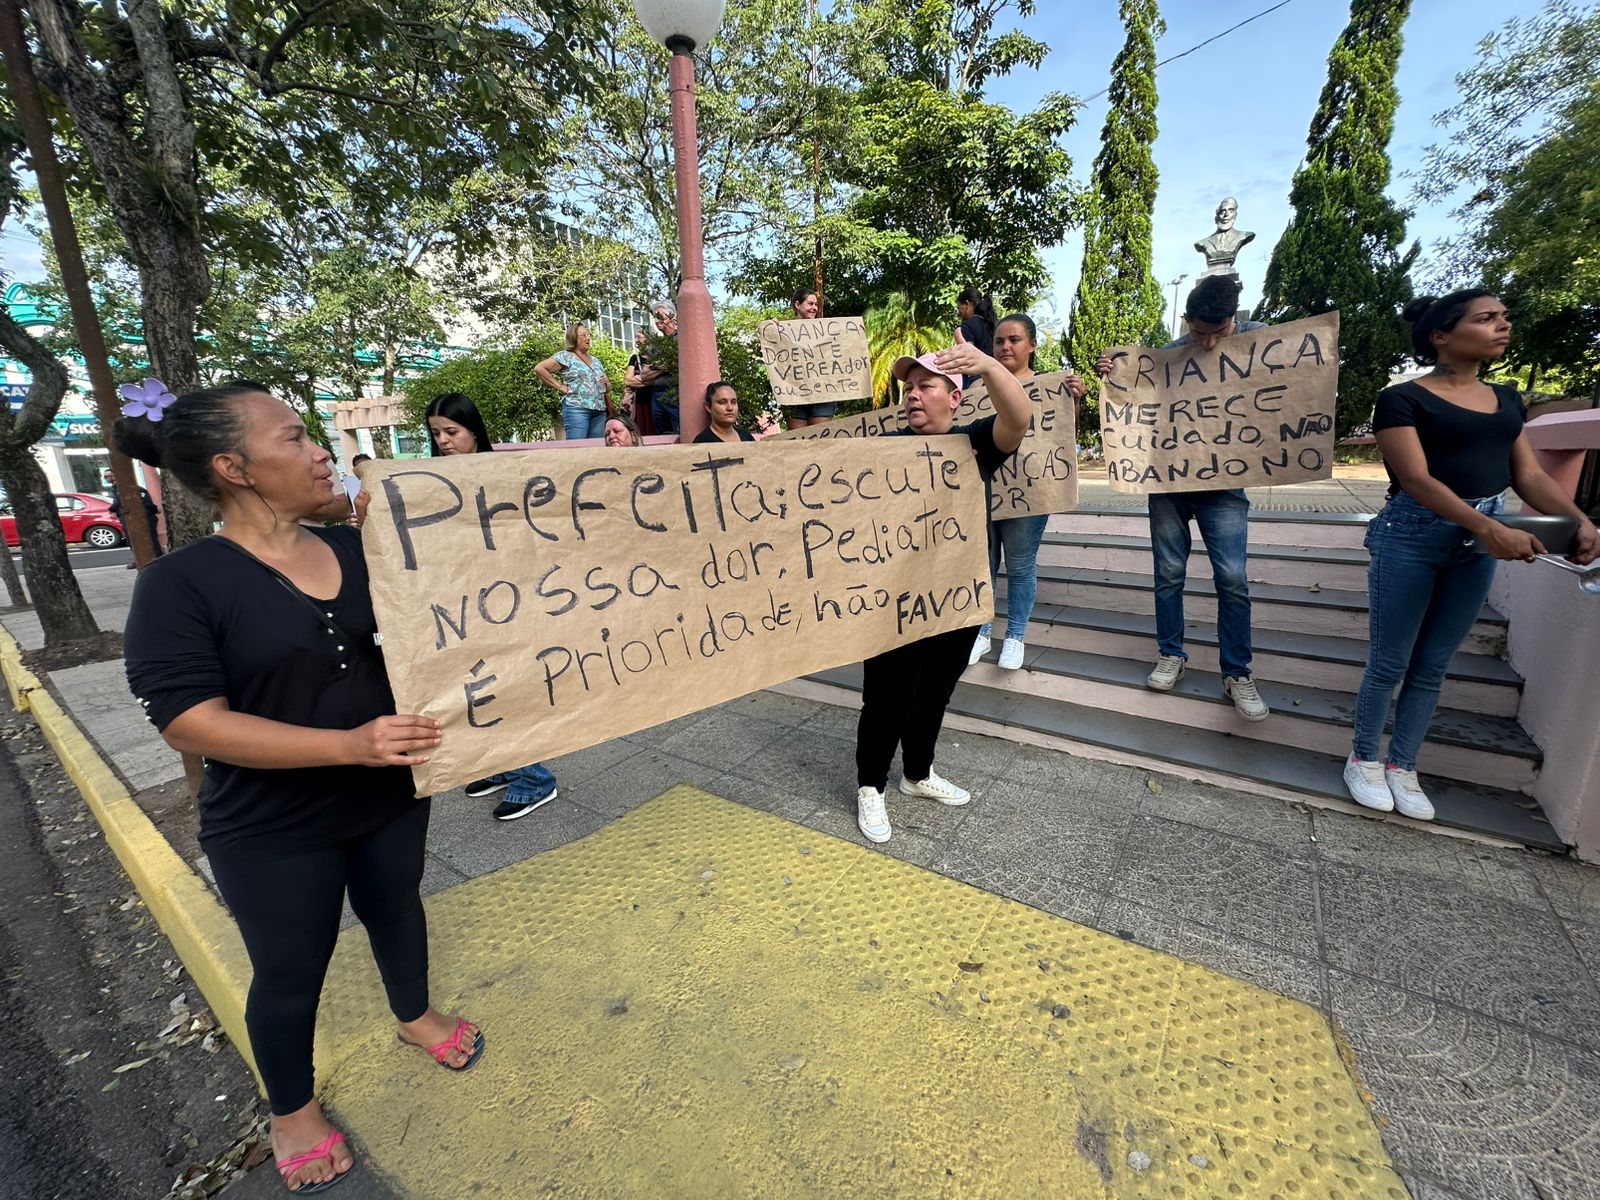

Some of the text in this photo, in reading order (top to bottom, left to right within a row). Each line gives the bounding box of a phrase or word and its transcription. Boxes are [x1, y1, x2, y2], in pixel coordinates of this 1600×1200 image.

[764, 342, 843, 366] DOENTE
[1106, 333, 1325, 392] CRIANÇA
[1105, 385, 1288, 426] MERECE
[1280, 413, 1333, 443] NÃO
[798, 442, 961, 510] escute
[464, 658, 504, 728] É
